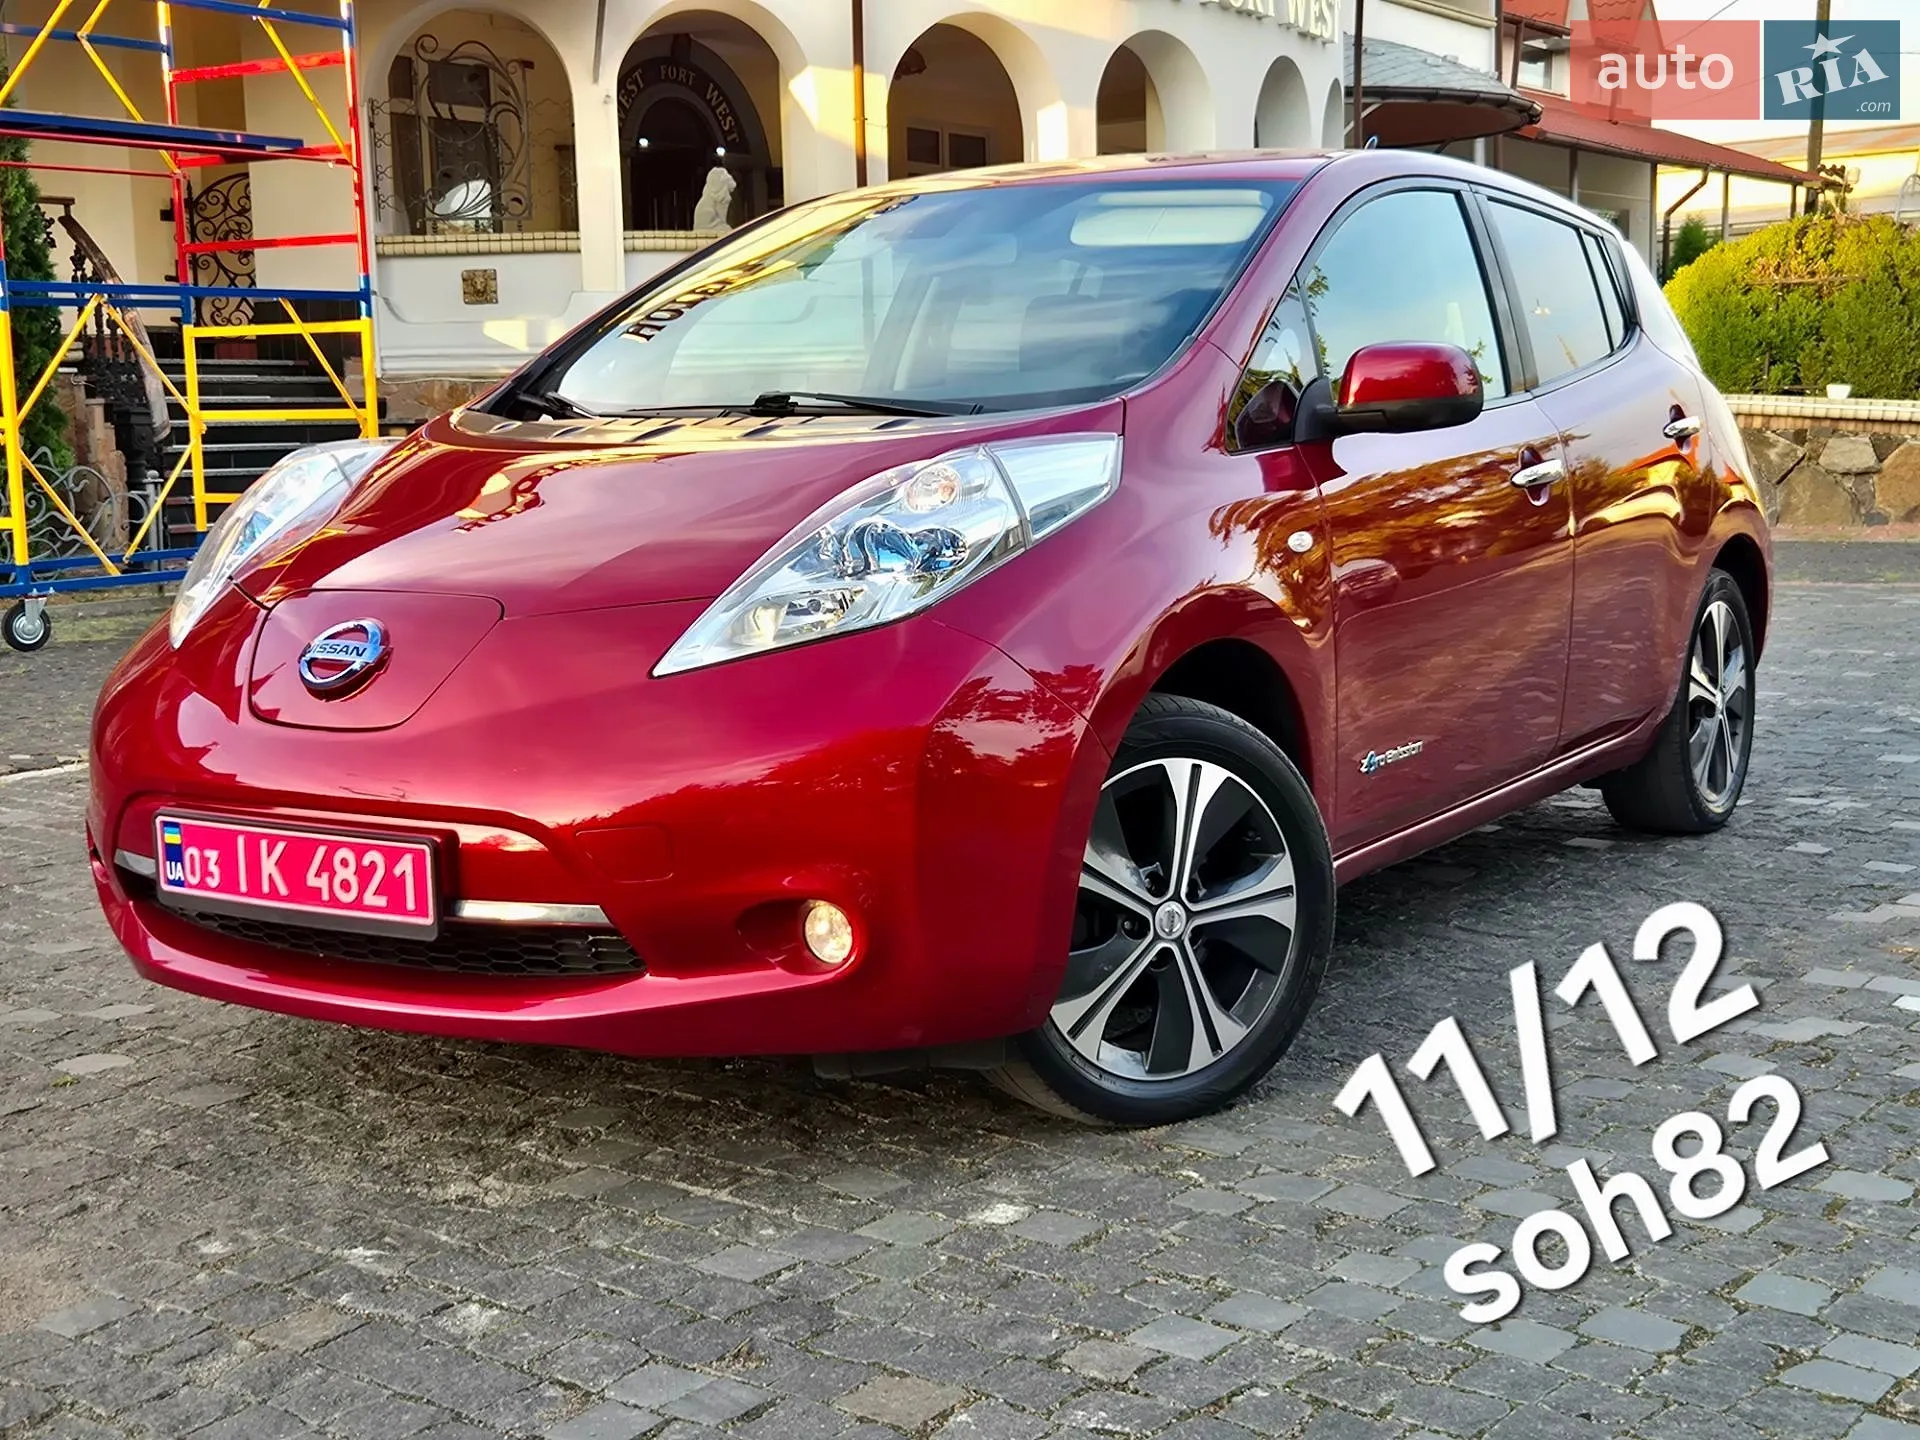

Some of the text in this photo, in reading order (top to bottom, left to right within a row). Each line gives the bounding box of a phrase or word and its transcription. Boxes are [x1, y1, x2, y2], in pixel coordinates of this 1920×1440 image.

[660, 64, 696, 86] FORT
[705, 82, 740, 144] WEST
[166, 860, 185, 882] UA
[184, 846, 221, 889] 03
[306, 843, 417, 913] 4821
